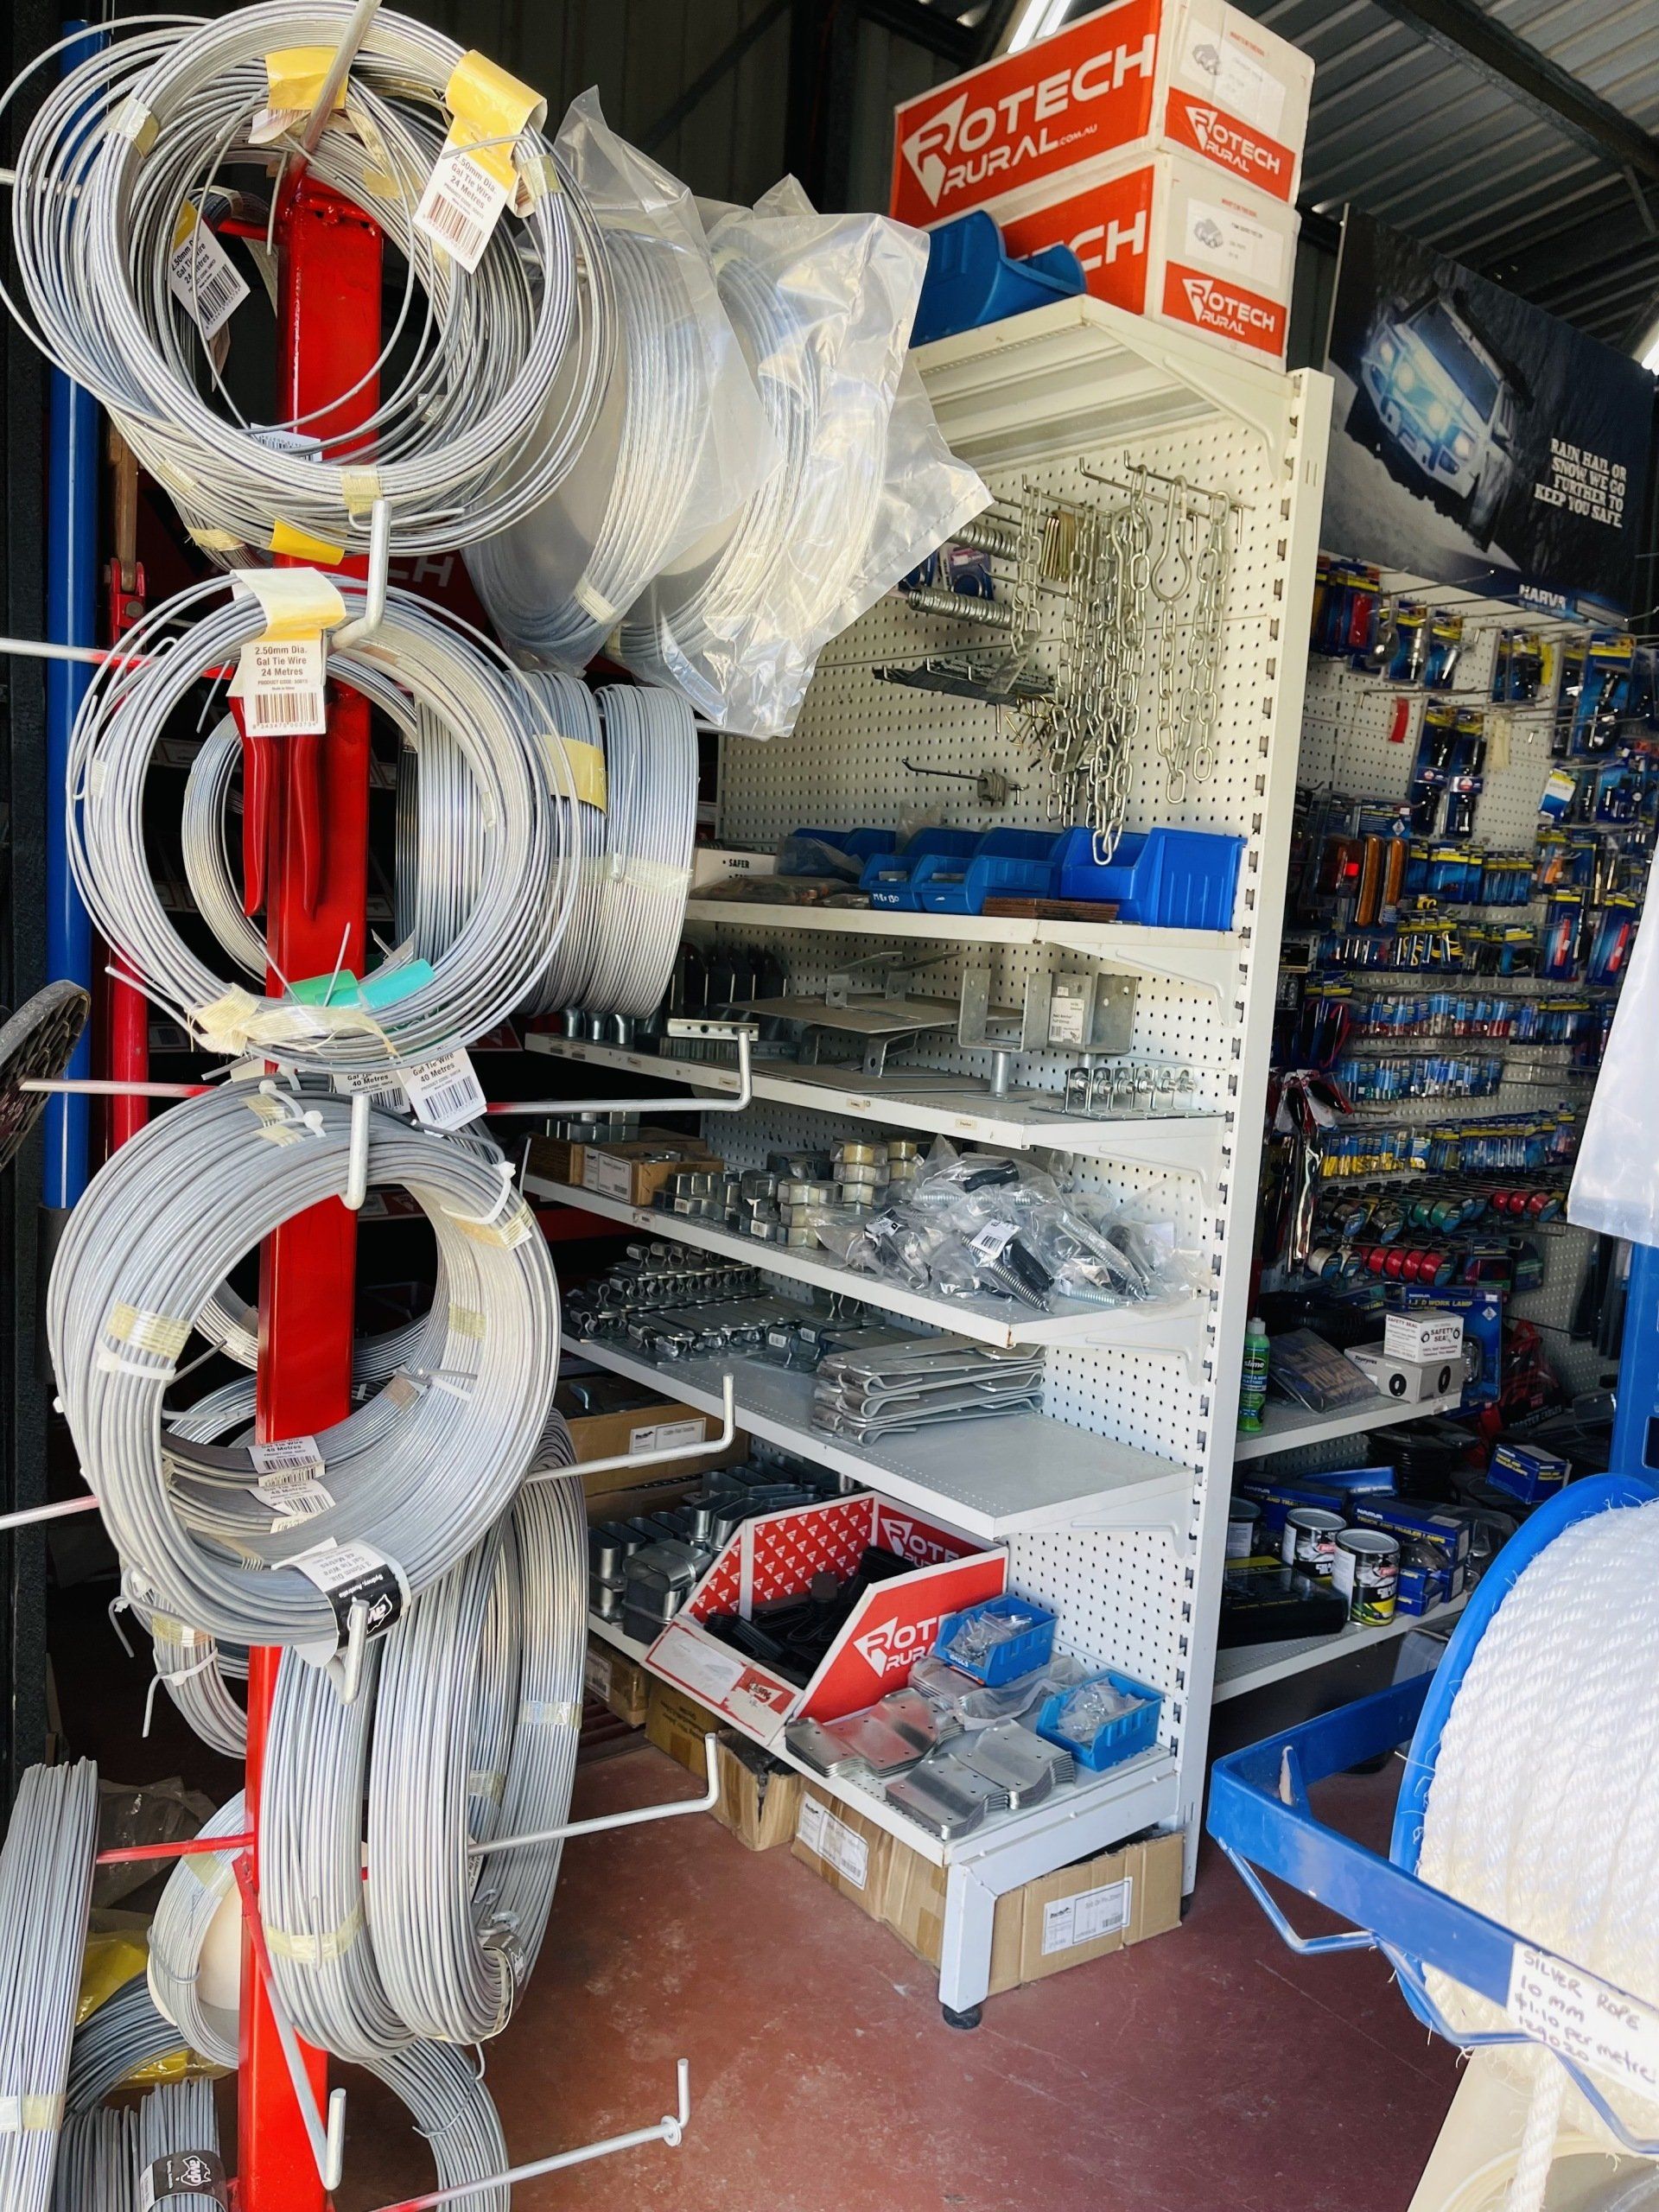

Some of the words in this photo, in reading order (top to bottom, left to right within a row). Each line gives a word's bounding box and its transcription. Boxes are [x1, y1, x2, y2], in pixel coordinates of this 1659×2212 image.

[901, 34, 1156, 208] ROTECH
[1185, 105, 1281, 175] ROTECH
[943, 127, 1059, 196] RURAL
[1204, 140, 1250, 174] RURAL
[450, 175, 461, 188] 24
[460, 183, 486, 209] Metres
[451, 163, 464, 178] Gal
[464, 173, 476, 188] Tie
[476, 182, 493, 203] Wire
[176, 264, 187, 279] Gal
[1182, 277, 1275, 334] ROTECH
[1201, 308, 1246, 336] RURAL
[1581, 450, 1611, 475] HAIL
[1611, 463, 1627, 482] OR
[1554, 473, 1607, 507] FURTHER
[1608, 493, 1624, 512] TO
[1589, 469, 1609, 491] WE
[1609, 479, 1625, 497] GO
[1534, 482, 1567, 508] KEEP
[1567, 495, 1591, 517] YOU
[254, 646, 289, 656] 2.50mm
[291, 645, 308, 655] Dia.
[256, 657, 270, 667] Gal
[272, 657, 286, 666] Tie
[287, 657, 308, 665] Wire
[261, 668, 272, 677] 24
[274, 667, 304, 677] Metres
[728, 858, 750, 869] SAFER
[412, 1065, 427, 1077] Gal
[426, 1060, 437, 1071] Tie
[437, 1052, 454, 1066] Wire
[420, 1073, 430, 1083] 40
[430, 1062, 455, 1077] Metres
[363, 1074, 389, 1084] Metres
[1431, 1327, 1453, 1336] SAFETY
[1357, 1516, 1378, 1525] TRUCK
[1380, 1521, 1394, 1529] AND
[1395, 1525, 1423, 1538] TRAILER
[1427, 1534, 1446, 1544] LAMPS
[1521, 1974, 1542, 1998] 10
[1523, 1949, 1583, 1999] SILVER
[1597, 1993, 1641, 2031] ROPE
